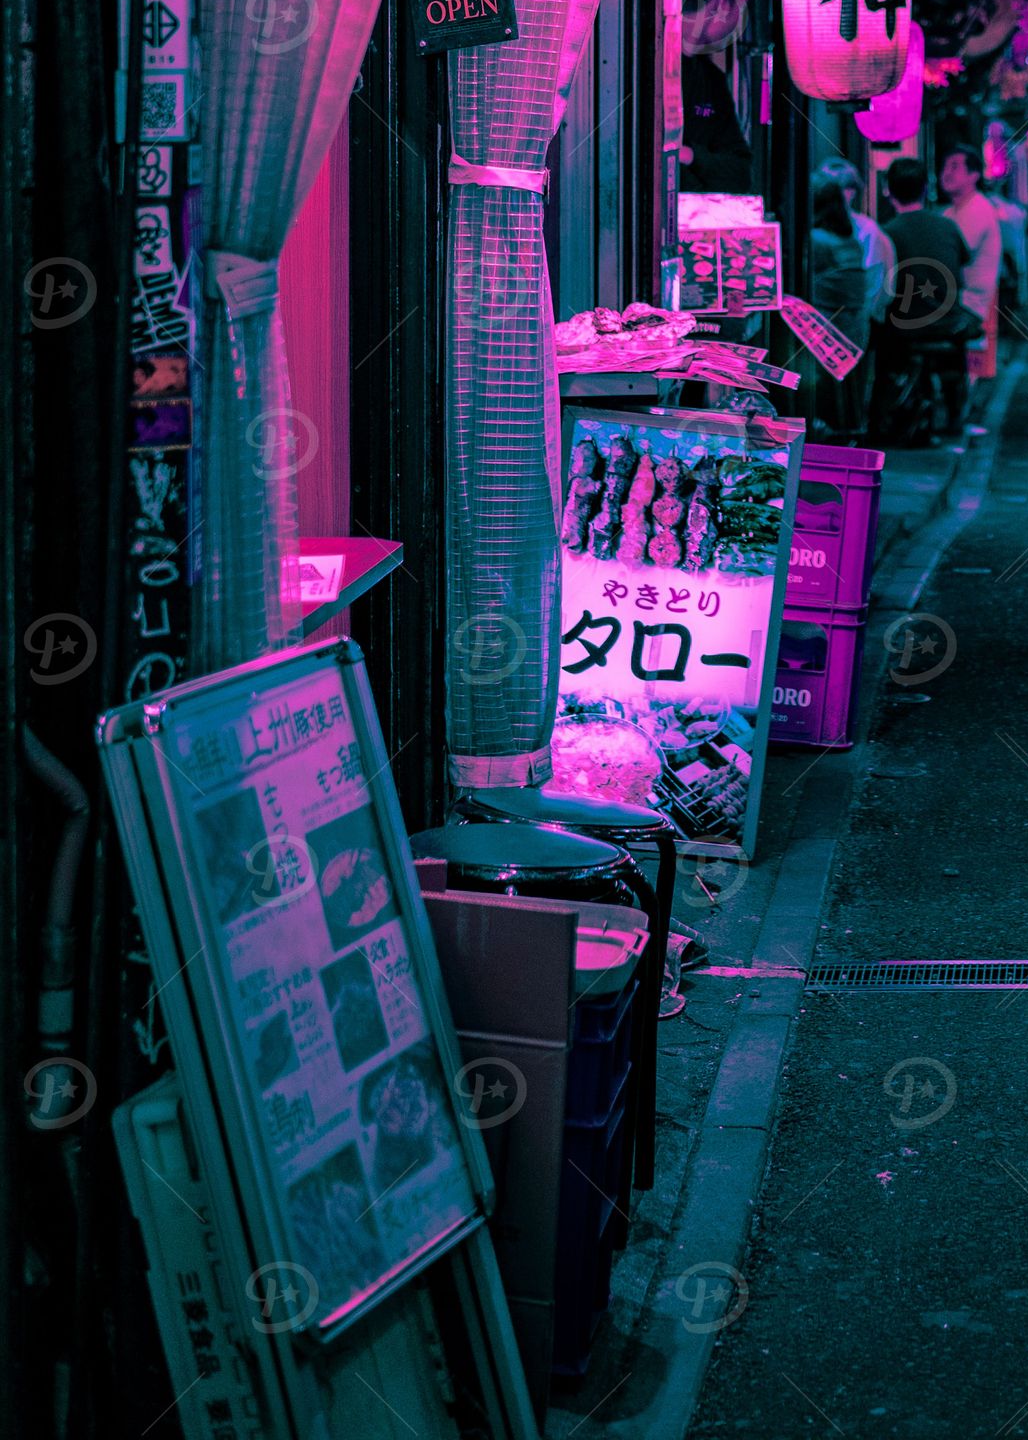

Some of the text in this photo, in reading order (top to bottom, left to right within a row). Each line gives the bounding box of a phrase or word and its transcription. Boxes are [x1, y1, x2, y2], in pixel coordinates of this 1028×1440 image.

[602, 579, 720, 617] やきとり
[562, 610, 751, 681] タロー
